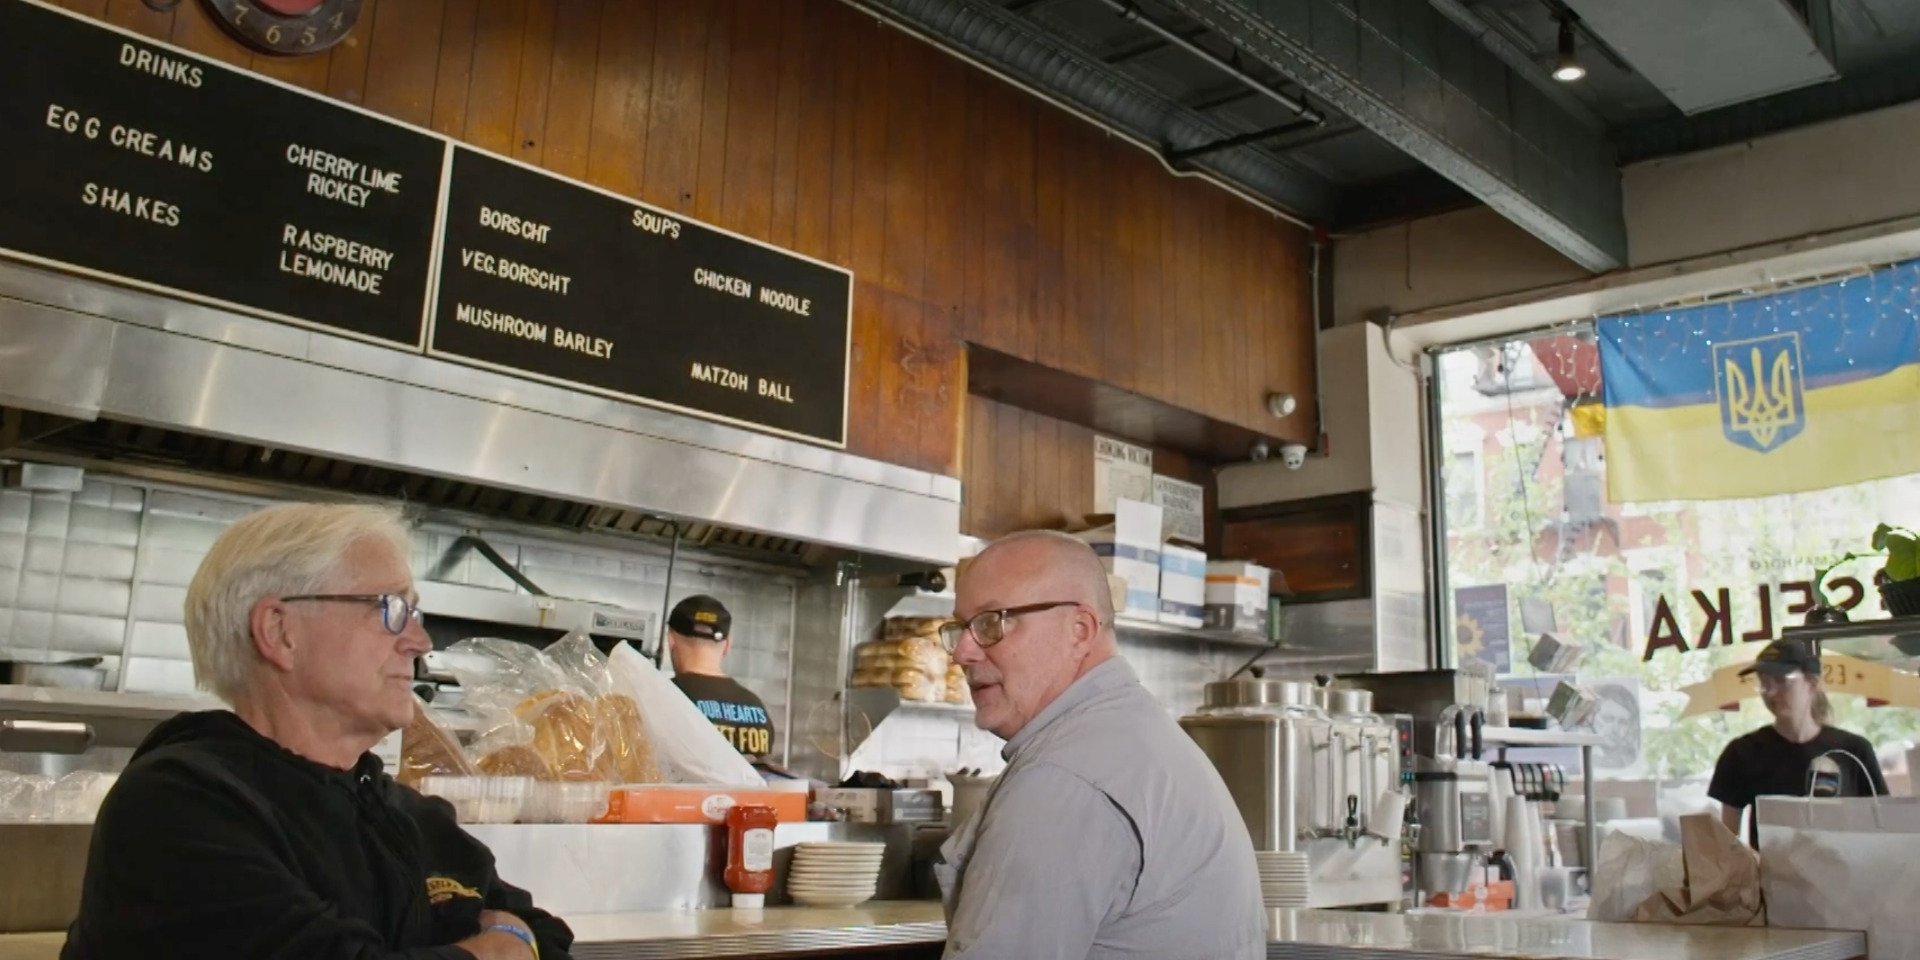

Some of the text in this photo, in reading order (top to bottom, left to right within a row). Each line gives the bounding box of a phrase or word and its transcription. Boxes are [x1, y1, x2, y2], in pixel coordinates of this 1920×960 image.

[234, 4, 249, 26] 7
[329, 12, 343, 30] 4
[266, 25, 281, 44] 6
[301, 26, 317, 46] 5
[120, 44, 203, 88] DRINKS
[47, 104, 213, 172] EGG CREAMS
[287, 144, 401, 193] CHERRY LIME
[83, 183, 179, 226] SHAKES
[307, 173, 370, 208] RICKEY
[480, 207, 551, 244] BORSCHT
[633, 210, 681, 240] SOUPS
[283, 224, 394, 271] RASPBERRY
[280, 251, 382, 295] LEMONADE
[694, 268, 811, 316] CHICKEN NOODLE
[457, 303, 614, 359] MUSHROOM BARLEY
[691, 363, 793, 403] MATZOH BALL
[721, 702, 767, 724] HEARTS
[738, 727, 769, 753] FOR
